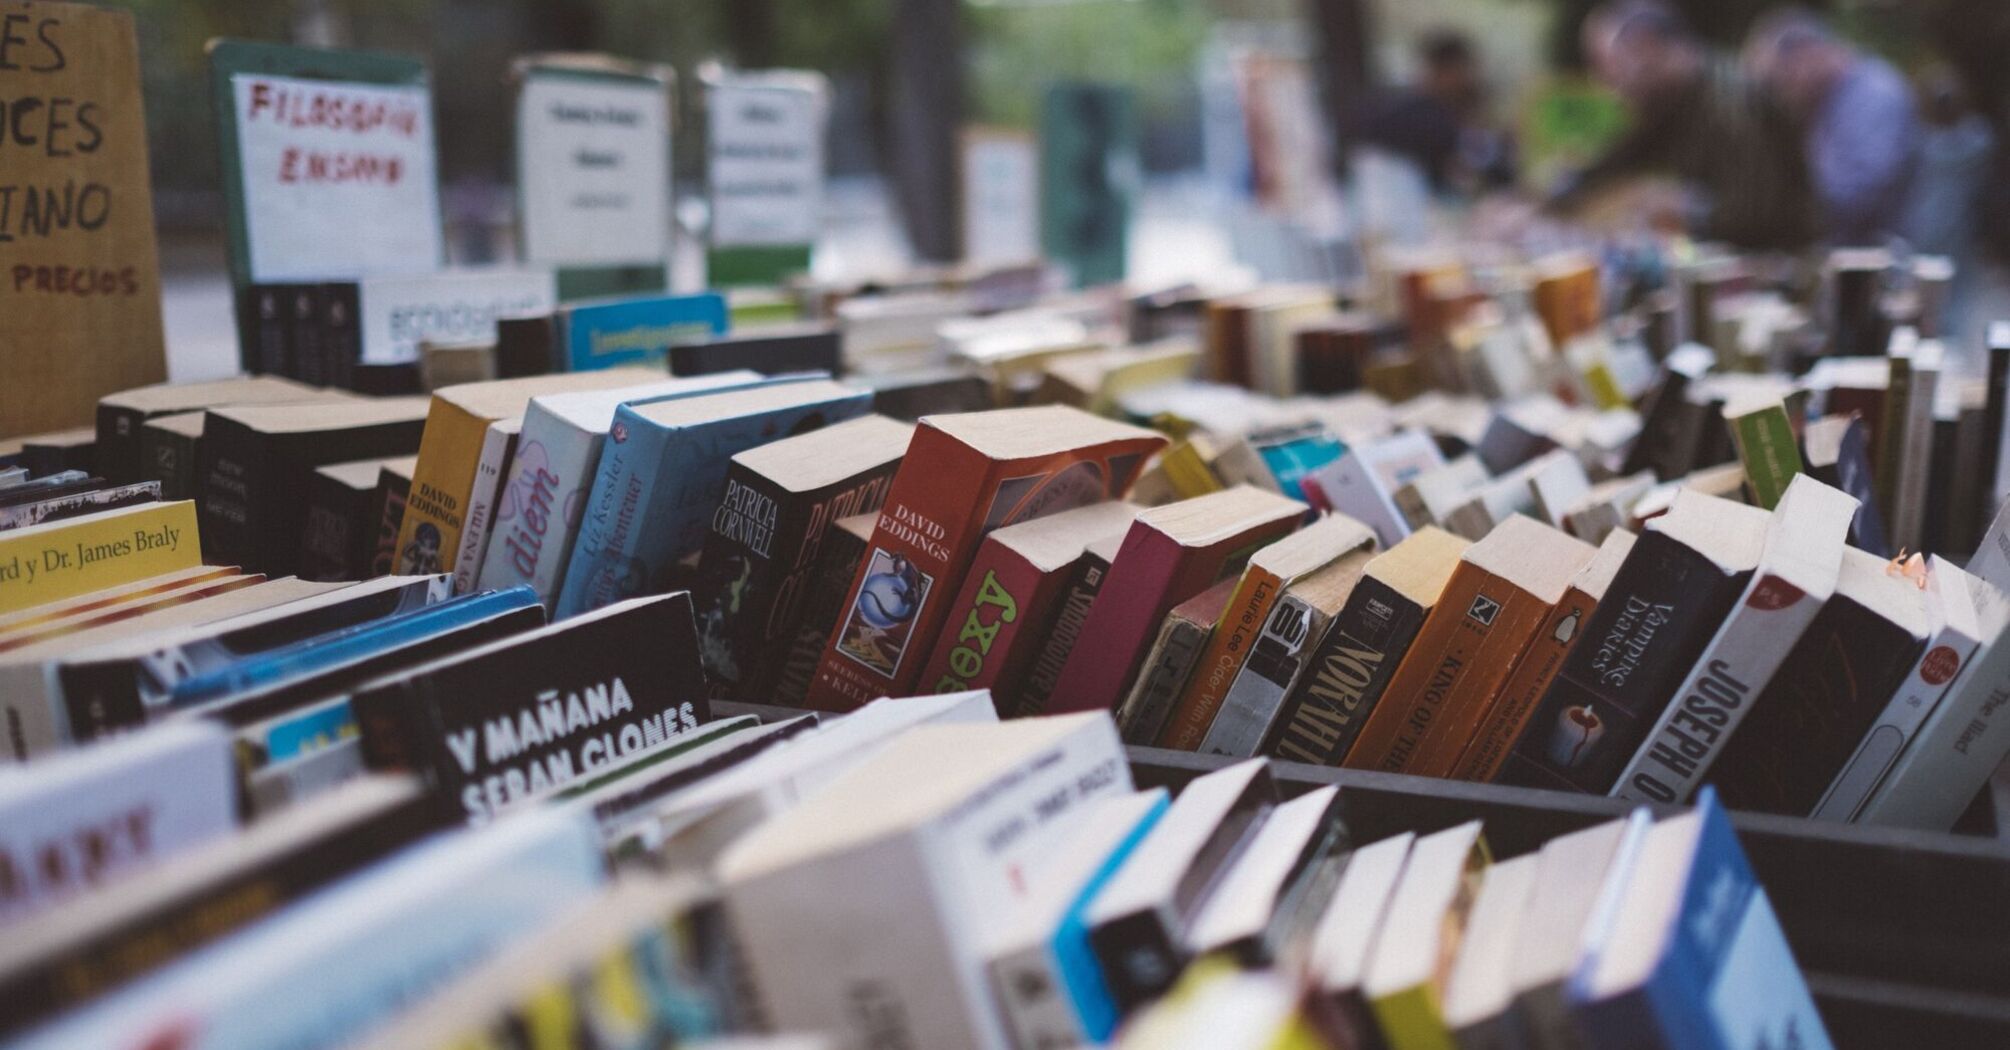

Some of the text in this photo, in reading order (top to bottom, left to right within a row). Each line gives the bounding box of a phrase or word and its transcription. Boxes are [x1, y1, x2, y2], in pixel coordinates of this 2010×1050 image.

[0, 97, 104, 156] CES
[409, 494, 461, 530] EDDINGS
[419, 483, 457, 512] DAVID
[583, 453, 624, 557] Liz Kessler
[722, 479, 778, 531] PATRICIA
[893, 503, 946, 542] DAVID
[26, 561, 37, 584] y
[42, 547, 73, 571] Dr.
[77, 538, 132, 569] James
[134, 526, 181, 552] Braly
[711, 505, 775, 560] CORNWELL
[878, 514, 951, 563] EDDINGS
[1243, 580, 1274, 625] Laurie
[1229, 623, 1252, 653] Lee
[1591, 595, 1650, 685] Diaries
[1612, 601, 1674, 688] Vampire
[1207, 654, 1235, 690] Cider
[1286, 629, 1386, 752] NORAH
[1424, 654, 1463, 706] KING
[445, 677, 634, 775] Y MAÑANA
[579, 701, 698, 768] CLONES
[1407, 705, 1432, 733] OF
[1645, 658, 1751, 780] JOSEPH
